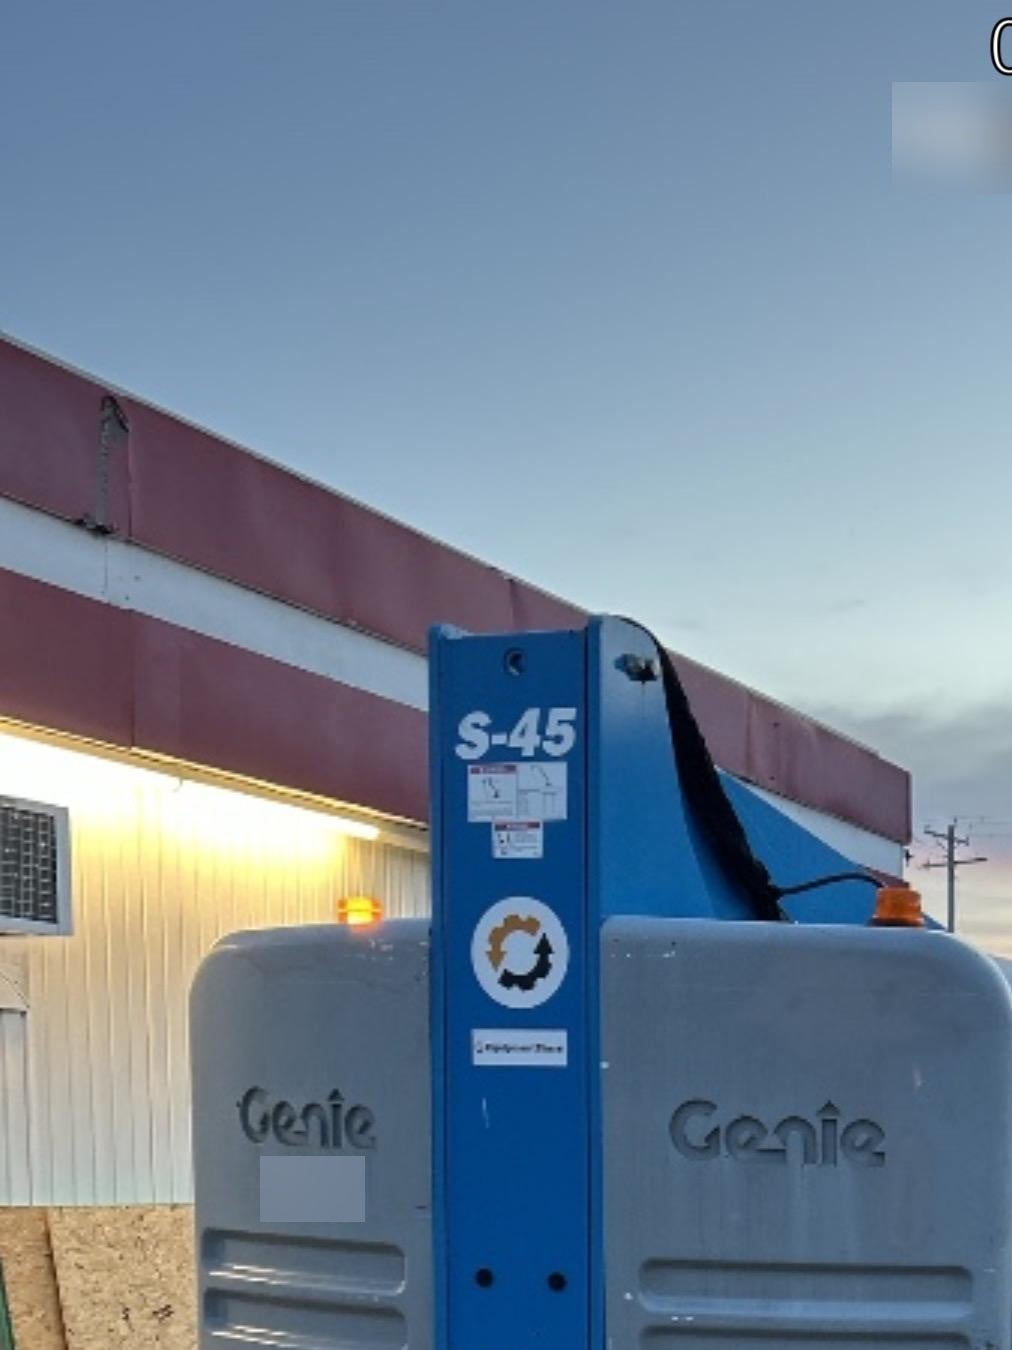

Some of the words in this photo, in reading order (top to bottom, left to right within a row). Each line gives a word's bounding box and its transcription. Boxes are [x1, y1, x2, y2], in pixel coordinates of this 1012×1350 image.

[454, 707, 577, 760] S-45
[240, 1085, 377, 1150] Genie
[668, 1099, 886, 1168] Genie
